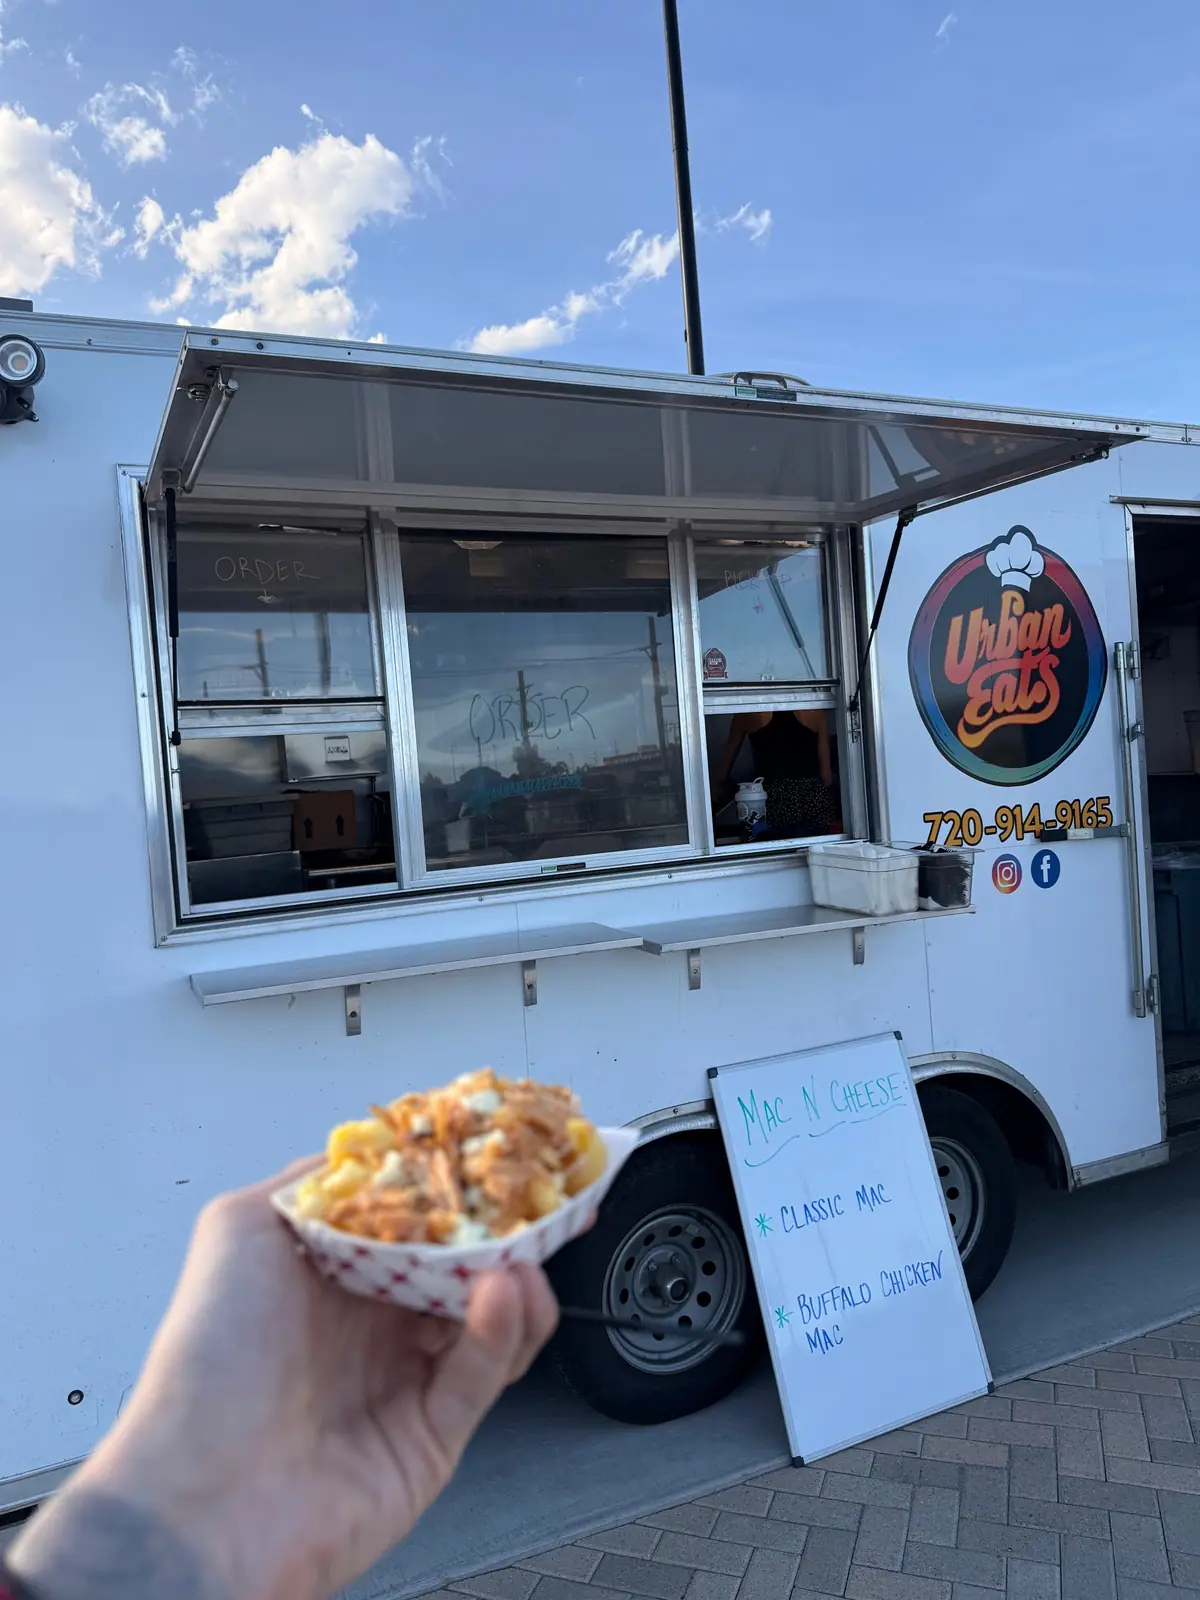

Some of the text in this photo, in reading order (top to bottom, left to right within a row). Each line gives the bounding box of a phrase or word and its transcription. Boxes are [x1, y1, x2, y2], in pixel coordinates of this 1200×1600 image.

[215, 556, 322, 585] ORDER
[944, 590, 1072, 684] Urban
[469, 685, 597, 745] ORDER
[956, 647, 1061, 748] Eats
[923, 796, 1114, 847] 720-914-9165
[736, 1088, 792, 1146] MAC
[780, 1183, 892, 1233] CLASSIC MAC
[797, 1250, 944, 1325] BUFFALO CHICKEN
[805, 1323, 844, 1355] MAC
